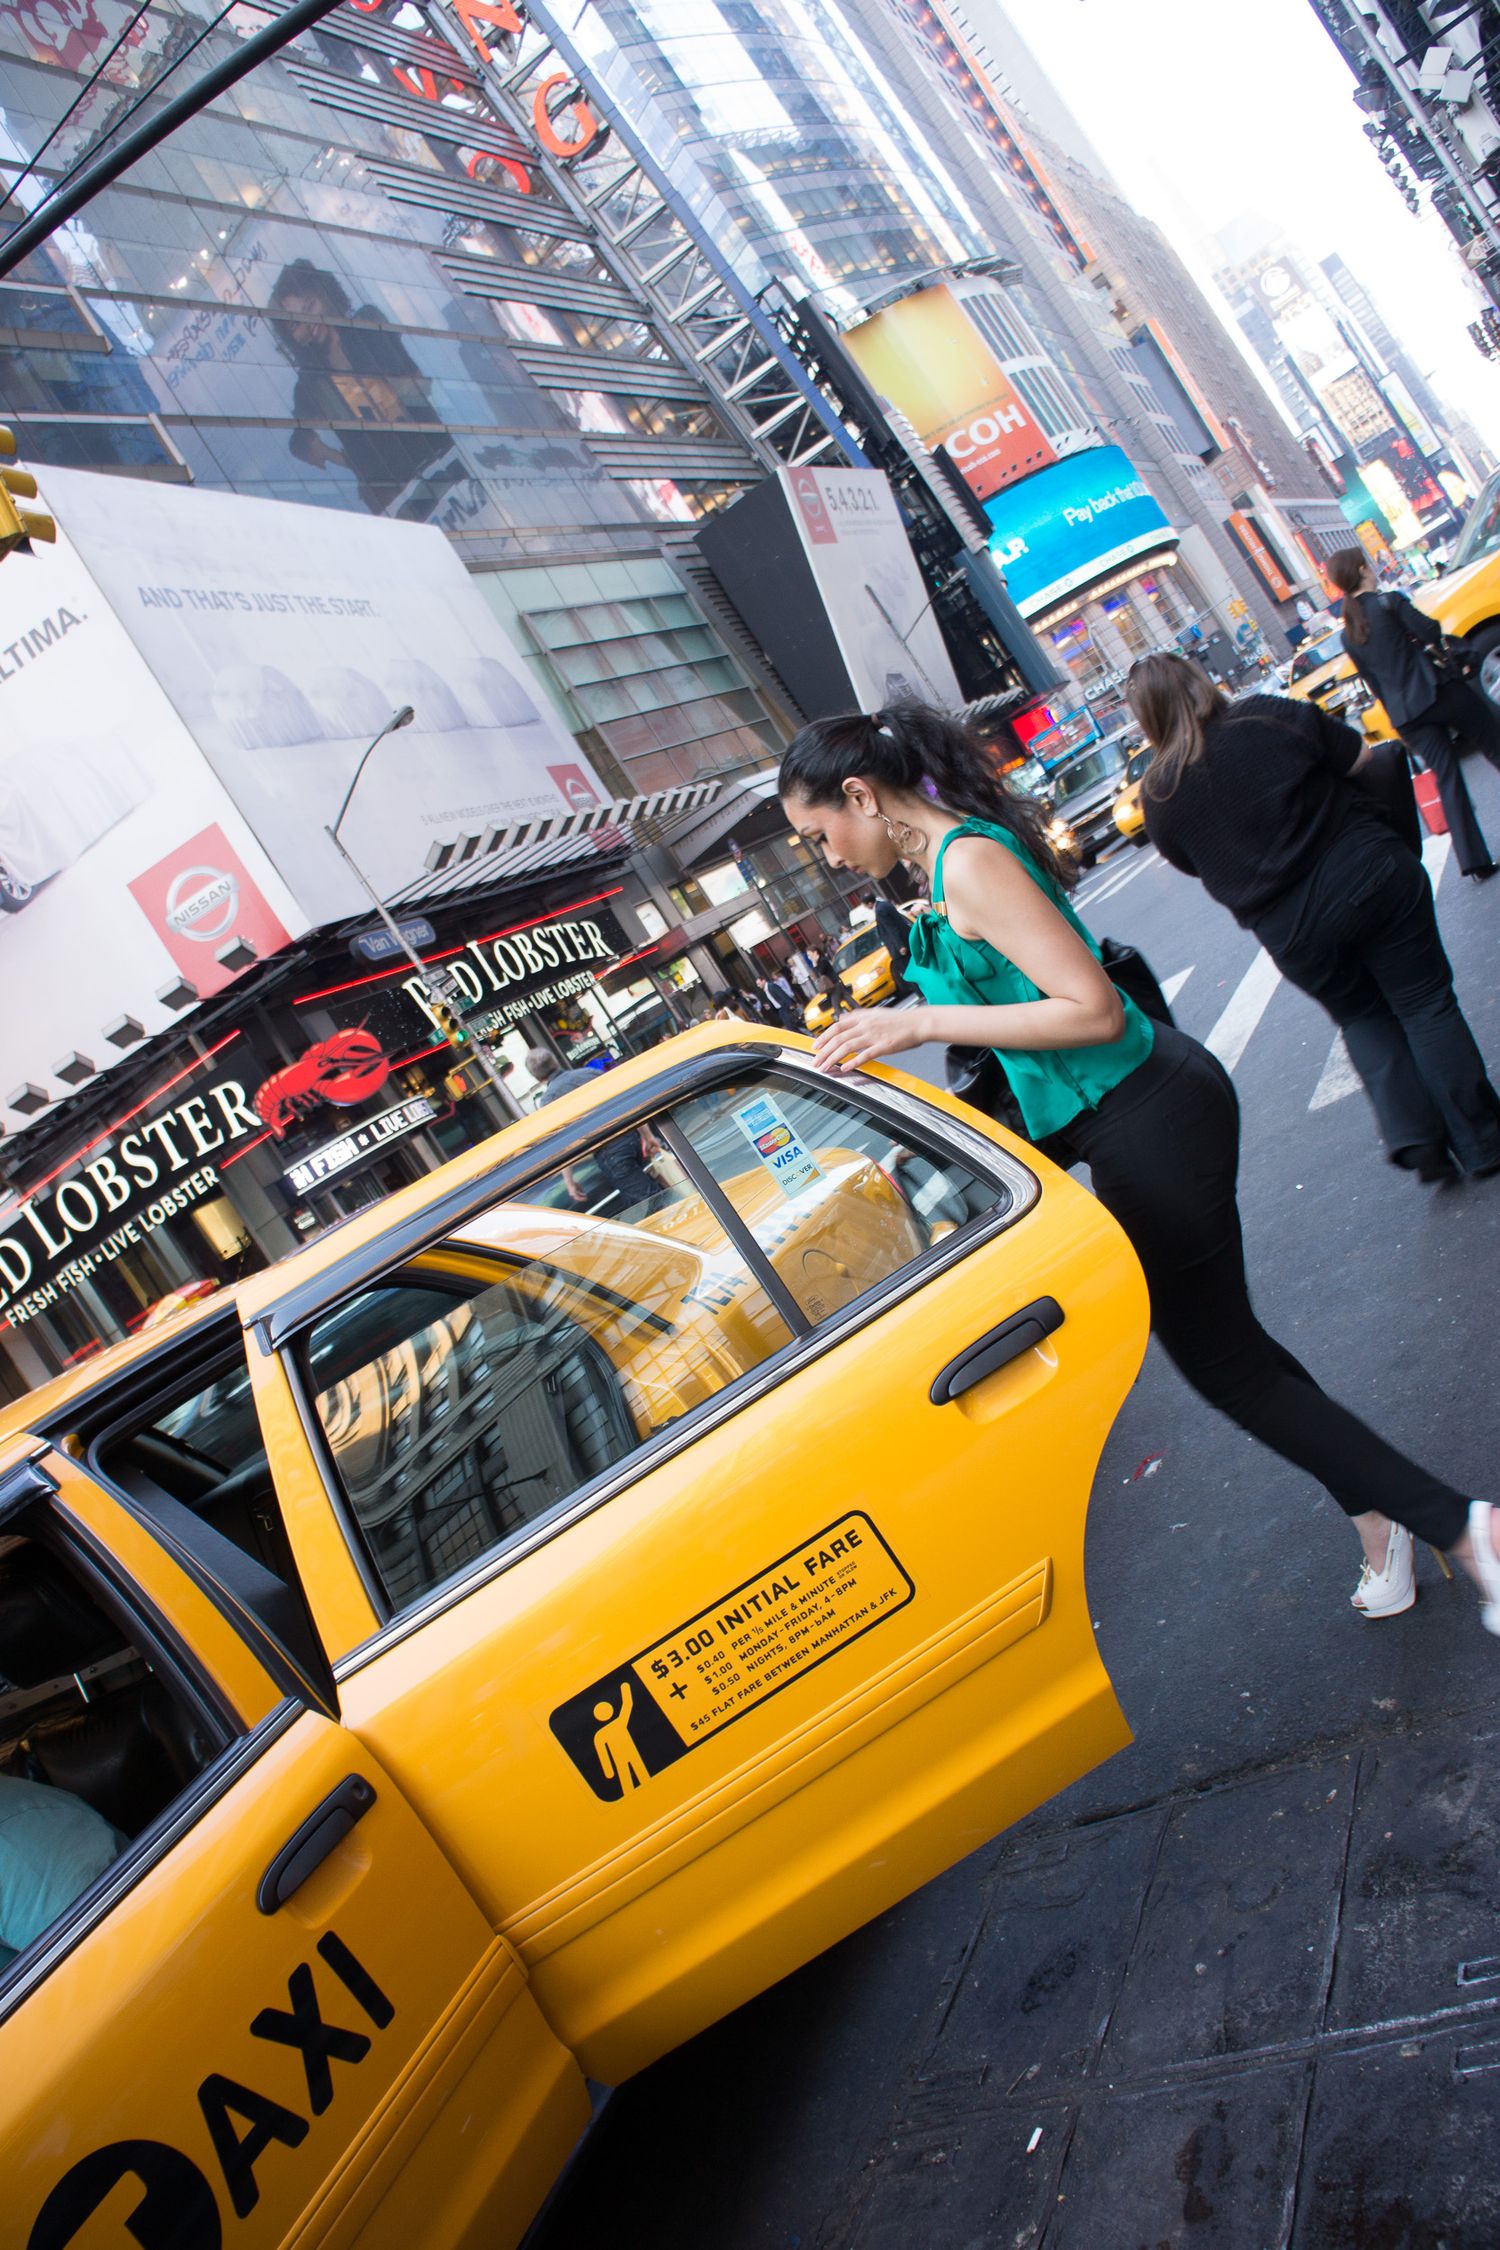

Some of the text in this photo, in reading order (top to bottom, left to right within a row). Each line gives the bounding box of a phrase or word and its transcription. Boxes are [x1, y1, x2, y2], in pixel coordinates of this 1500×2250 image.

[929, 404, 1026, 460] COH
[1062, 505, 1094, 527] Pay
[1087, 490, 1116, 514] back
[137, 586, 381, 618] AND THAT'S JUST THE START.
[0, 606, 89, 684] LTIMA.
[173, 881, 232, 925] NISSAN
[465, 919, 615, 992] LOBSTER
[503, 998, 531, 1021] FISH
[530, 988, 557, 1010] LIVE
[552, 970, 599, 999] LOBSTER
[18, 1080, 263, 1260] LOBSTER
[309, 1137, 360, 1177] FISH
[369, 1108, 409, 1142] LIVE
[772, 1146, 803, 1169] VISA
[782, 1163, 813, 1186] DISCOVER
[4, 1166, 220, 1329] FRESH FISH LIVE LOBSTER
[651, 1528, 863, 1680] $3.00 INITIAL FARE
[696, 1650, 726, 1674] $0.40
[731, 1633, 753, 1651] PER
[764, 1609, 789, 1628] MILE
[790, 1602, 798, 1611] &
[798, 1576, 837, 1606] MINUTE
[690, 1587, 898, 1731] $45 FLAT FARE BETWEEN MANHATTAN & JFK
[704, 1662, 734, 1685] $1.00
[712, 1672, 741, 1696] $0.50
[746, 1644, 788, 1672] NIGHTS,
